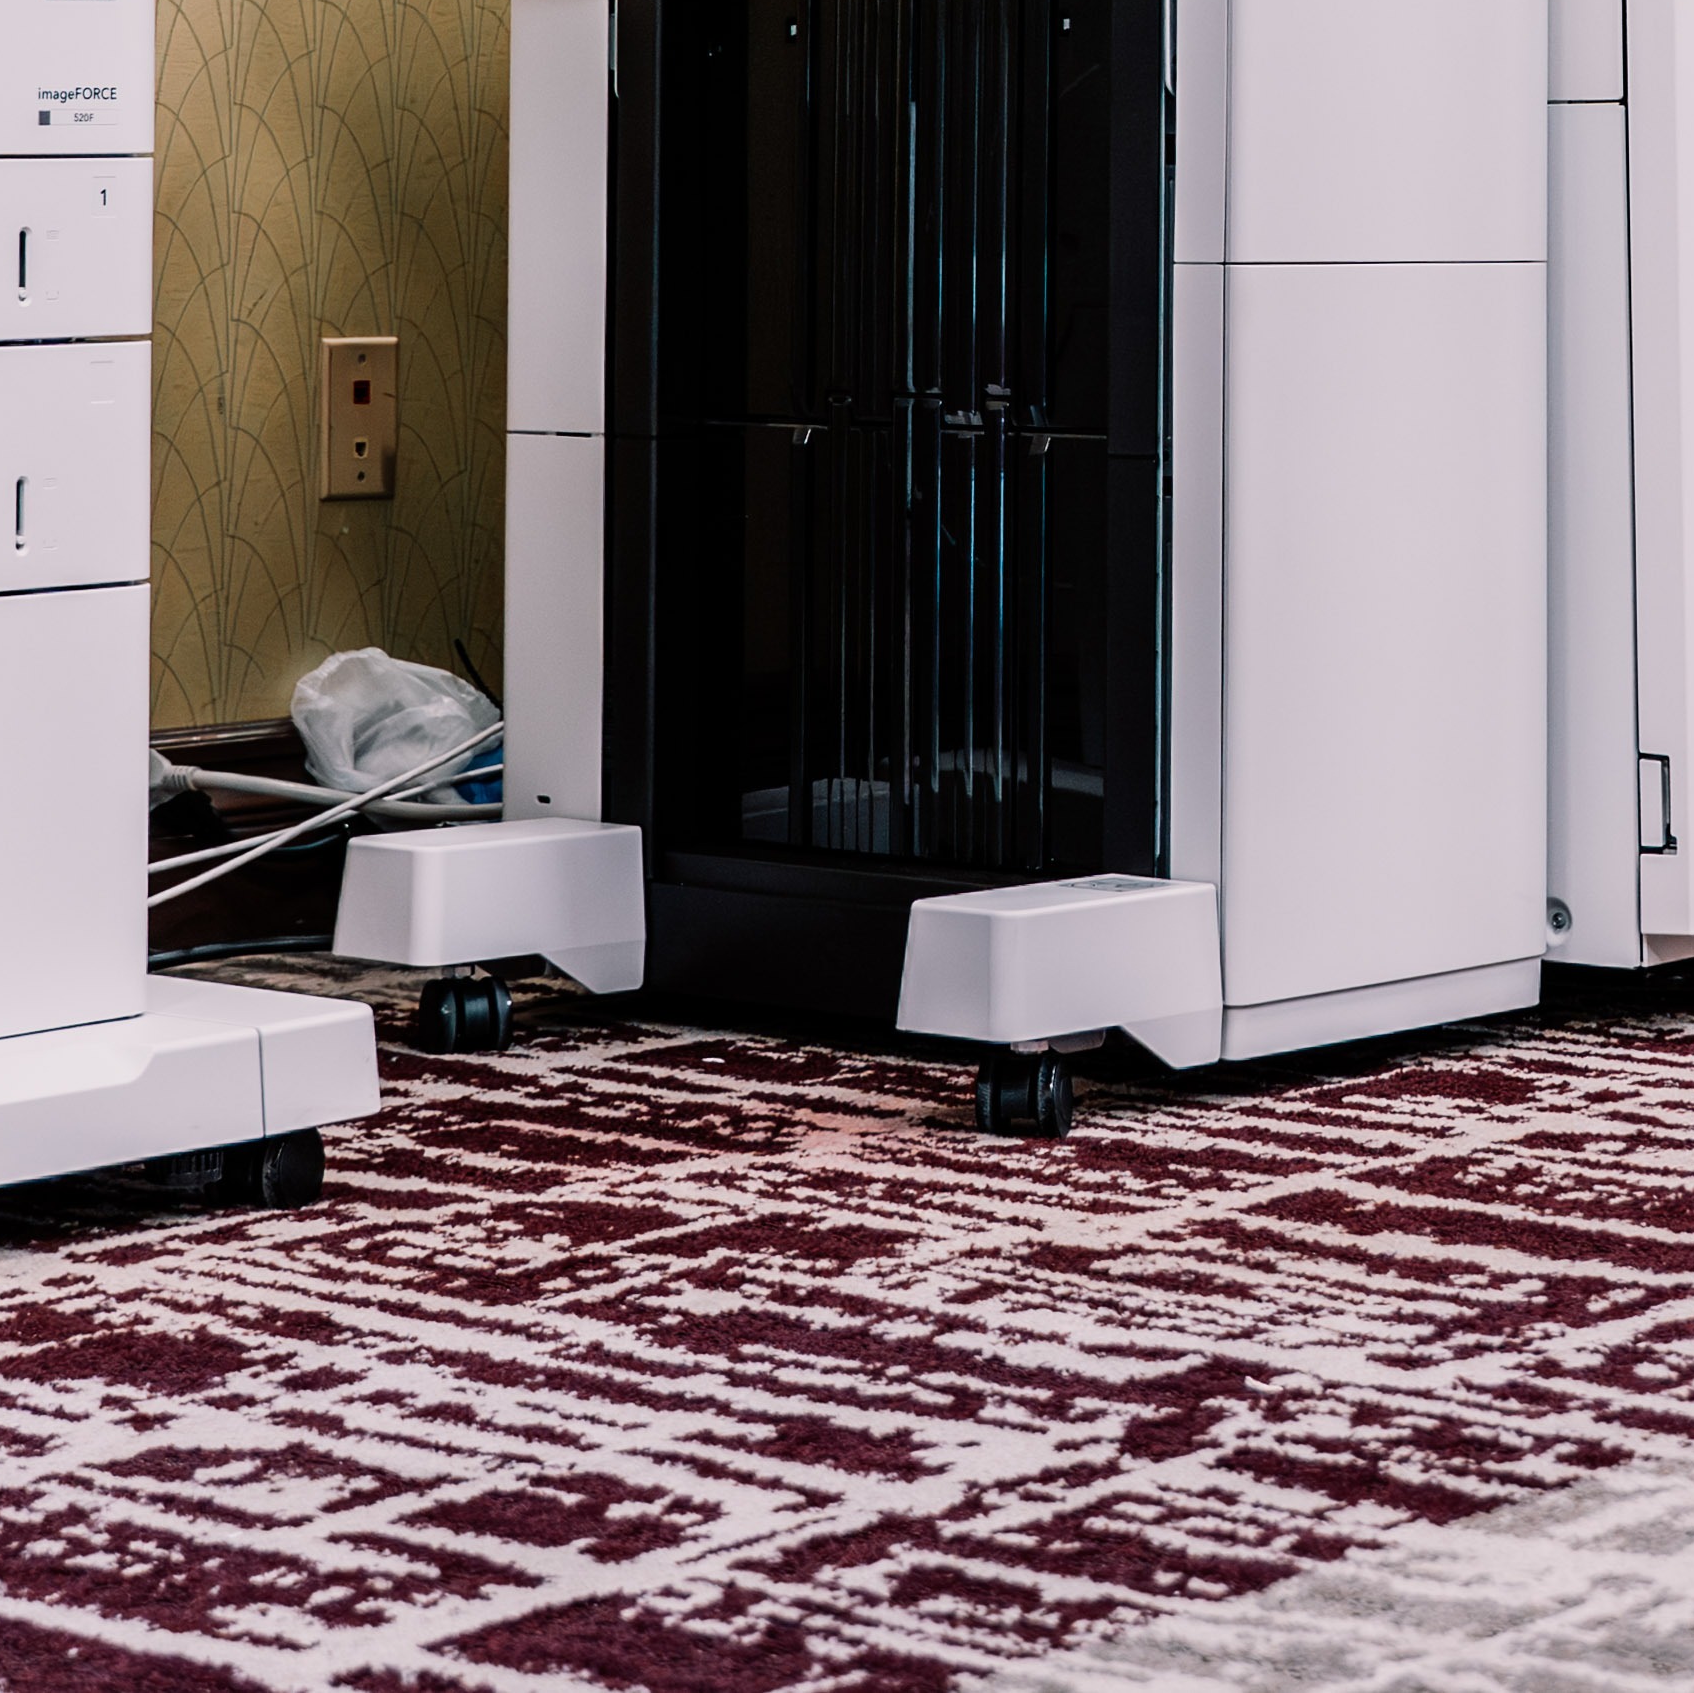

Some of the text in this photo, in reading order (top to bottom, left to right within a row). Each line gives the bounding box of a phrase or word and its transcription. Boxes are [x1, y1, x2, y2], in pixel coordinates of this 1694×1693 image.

[38, 87, 118, 104] imageFORCE
[74, 112, 95, 123] 520F
[100, 188, 107, 206] 1
